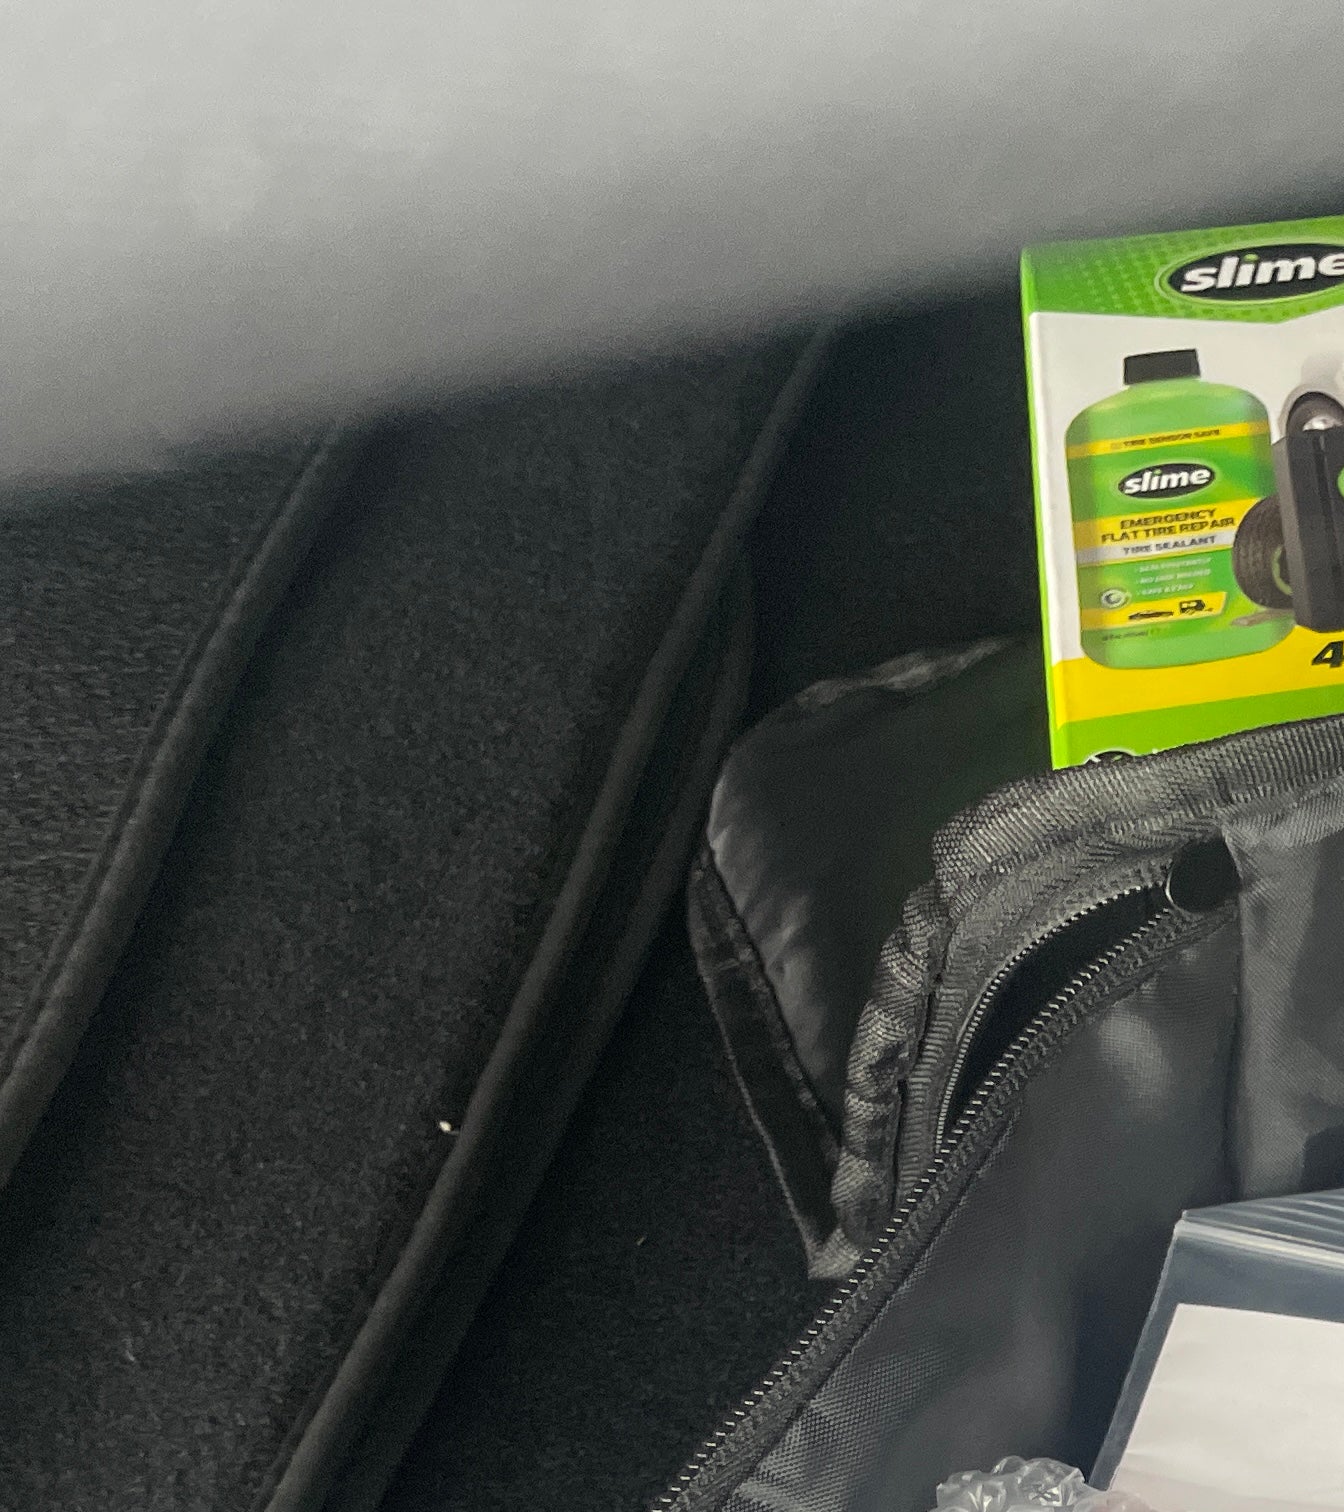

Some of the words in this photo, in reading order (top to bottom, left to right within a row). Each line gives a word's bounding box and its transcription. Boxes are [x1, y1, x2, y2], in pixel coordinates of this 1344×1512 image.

[1123, 467, 1212, 495] slime
[1100, 529, 1140, 545] FLAT
[1143, 525, 1178, 539] TIRE
[1179, 516, 1236, 534] REPAIR
[1120, 508, 1217, 530] EMERGENCY
[1123, 543, 1153, 556] TIRE
[1155, 534, 1217, 552] SEALANT
